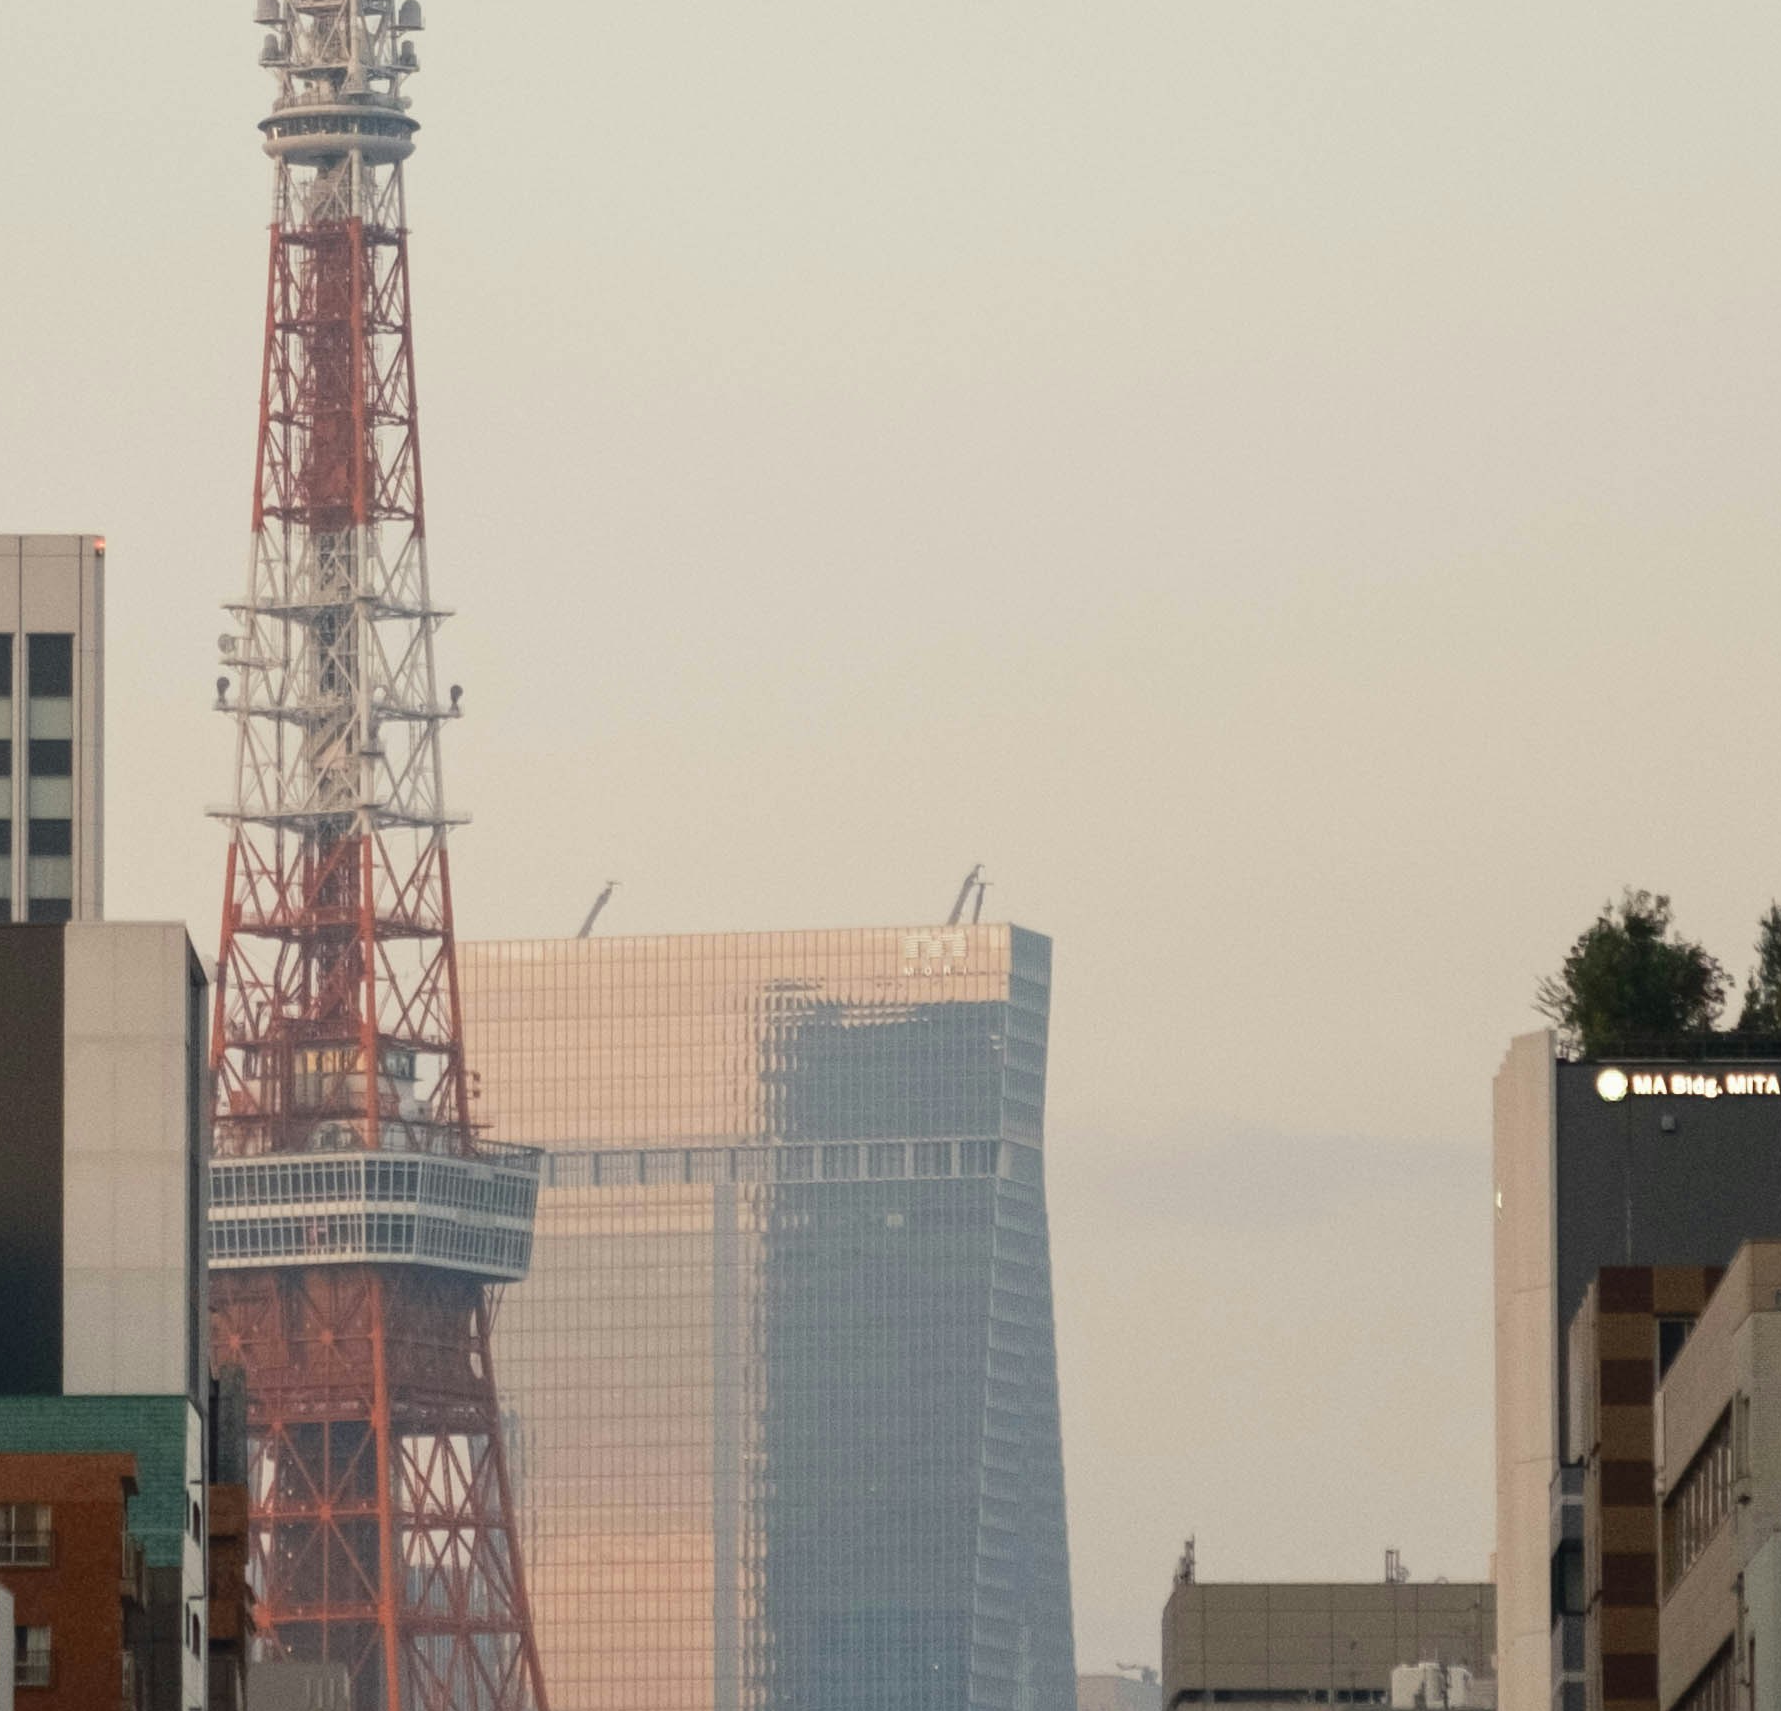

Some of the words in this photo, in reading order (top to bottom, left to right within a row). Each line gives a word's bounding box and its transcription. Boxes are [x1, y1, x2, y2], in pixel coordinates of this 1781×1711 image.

[1632, 1074, 1667, 1095] MA
[1671, 1074, 1723, 1099] Bldg.
[1726, 1073, 1781, 1095] MITA
